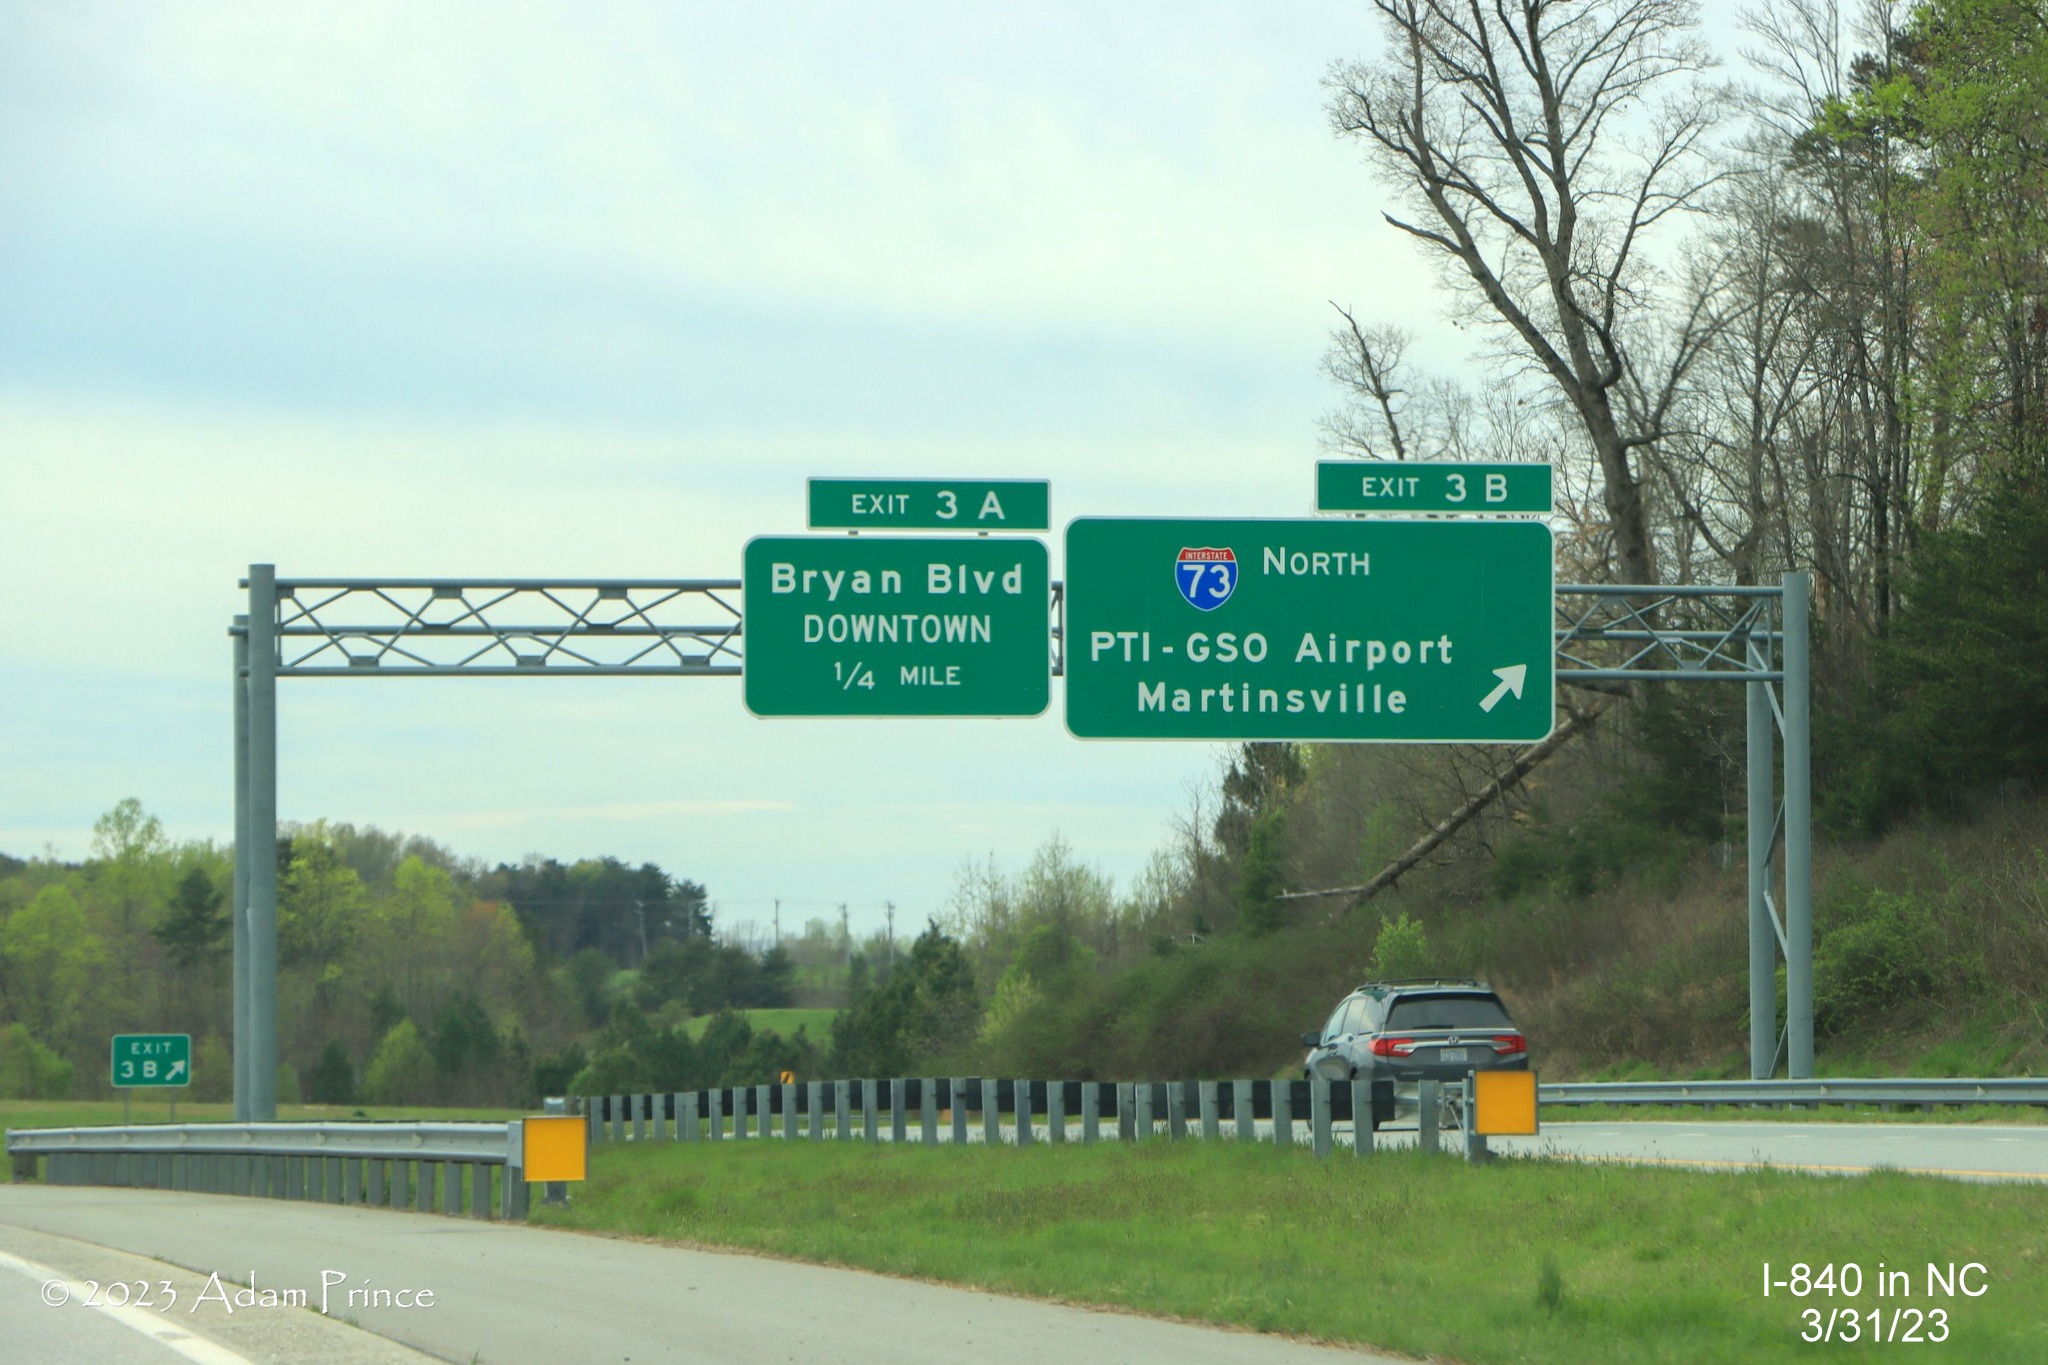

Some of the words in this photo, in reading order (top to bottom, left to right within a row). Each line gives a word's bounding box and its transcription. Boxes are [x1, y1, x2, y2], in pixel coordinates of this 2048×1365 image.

[1362, 476, 1419, 498] EXIT
[1445, 474, 1468, 503] 3
[1484, 473, 1508, 502] B
[852, 494, 909, 514] EXIT
[936, 490, 958, 519] 3
[977, 491, 1005, 520] A
[1185, 551, 1228, 561] INTERSTATE
[1263, 547, 1370, 576] NORTH
[771, 562, 902, 601] Bryan
[927, 563, 1022, 594] Blvd
[1182, 563, 1231, 599] 73
[803, 614, 991, 643] DOWNTOWN
[1295, 632, 1453, 671] Airport
[900, 666, 961, 685] MILE
[1137, 681, 1408, 713] Martinsville
[131, 1042, 171, 1055] EXIT
[120, 1060, 134, 1078] 3
[143, 1060, 157, 1078] B
